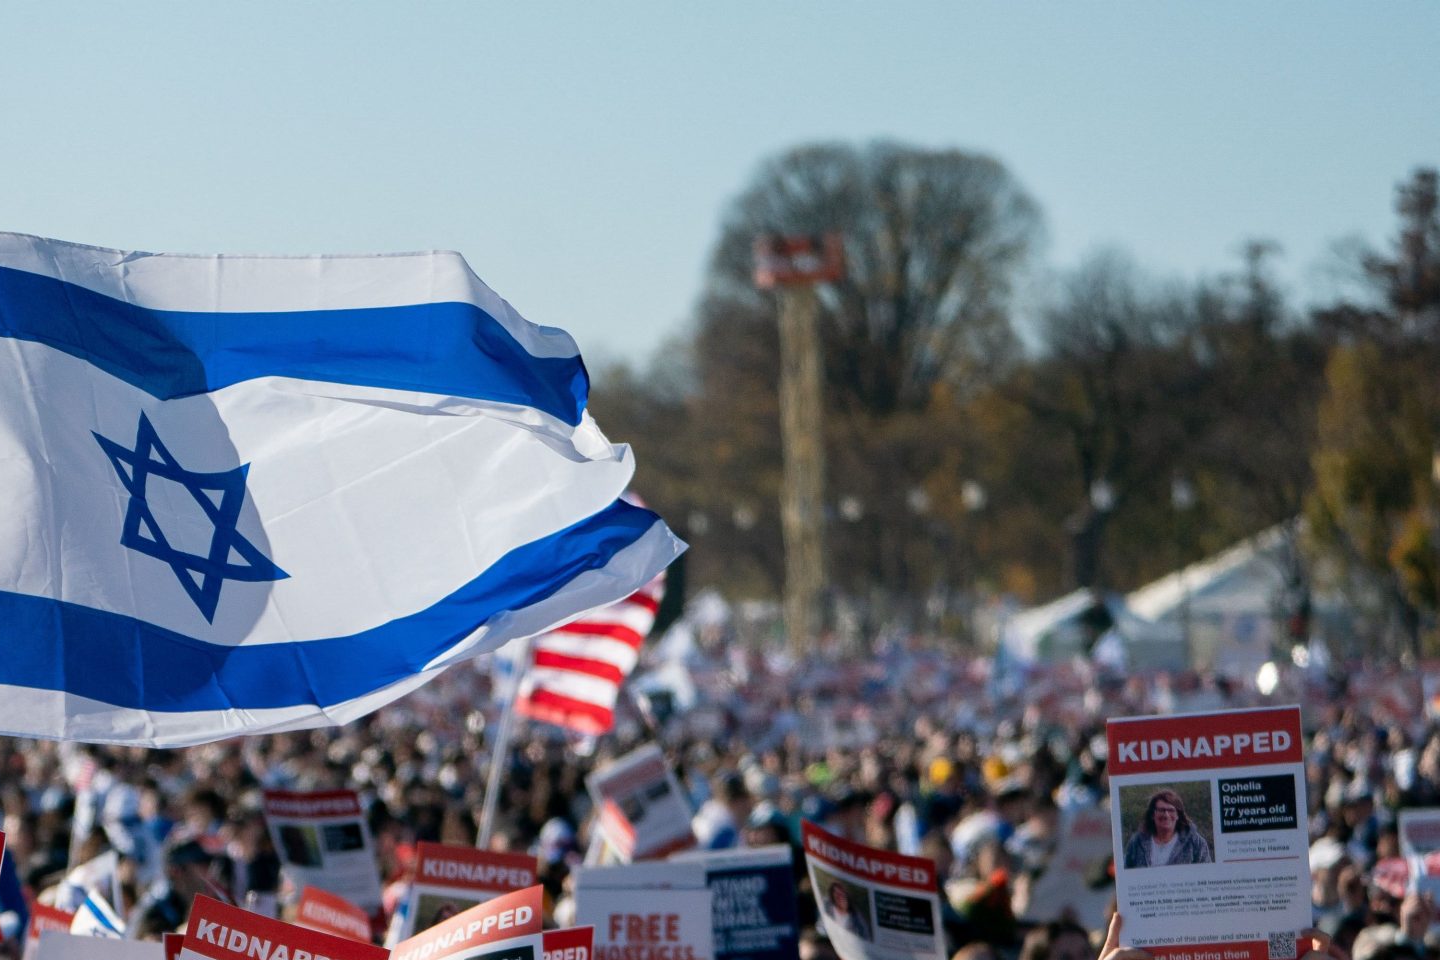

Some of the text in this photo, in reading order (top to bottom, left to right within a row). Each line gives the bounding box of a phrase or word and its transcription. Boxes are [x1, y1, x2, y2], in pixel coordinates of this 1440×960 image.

[1118, 731, 1292, 763] KIDNAPPED
[1221, 781, 1261, 794] Ophelia
[1223, 794, 1266, 806] Roitman
[1224, 804, 1286, 818] 77 years old
[1223, 815, 1294, 827] Israeli-Argentinian
[808, 838, 929, 885] KIDNAPPED
[423, 858, 533, 888] KIDNAPPED
[608, 914, 680, 941] FREE
[1194, 951, 1221, 960] bring
[1223, 950, 1250, 959] them
